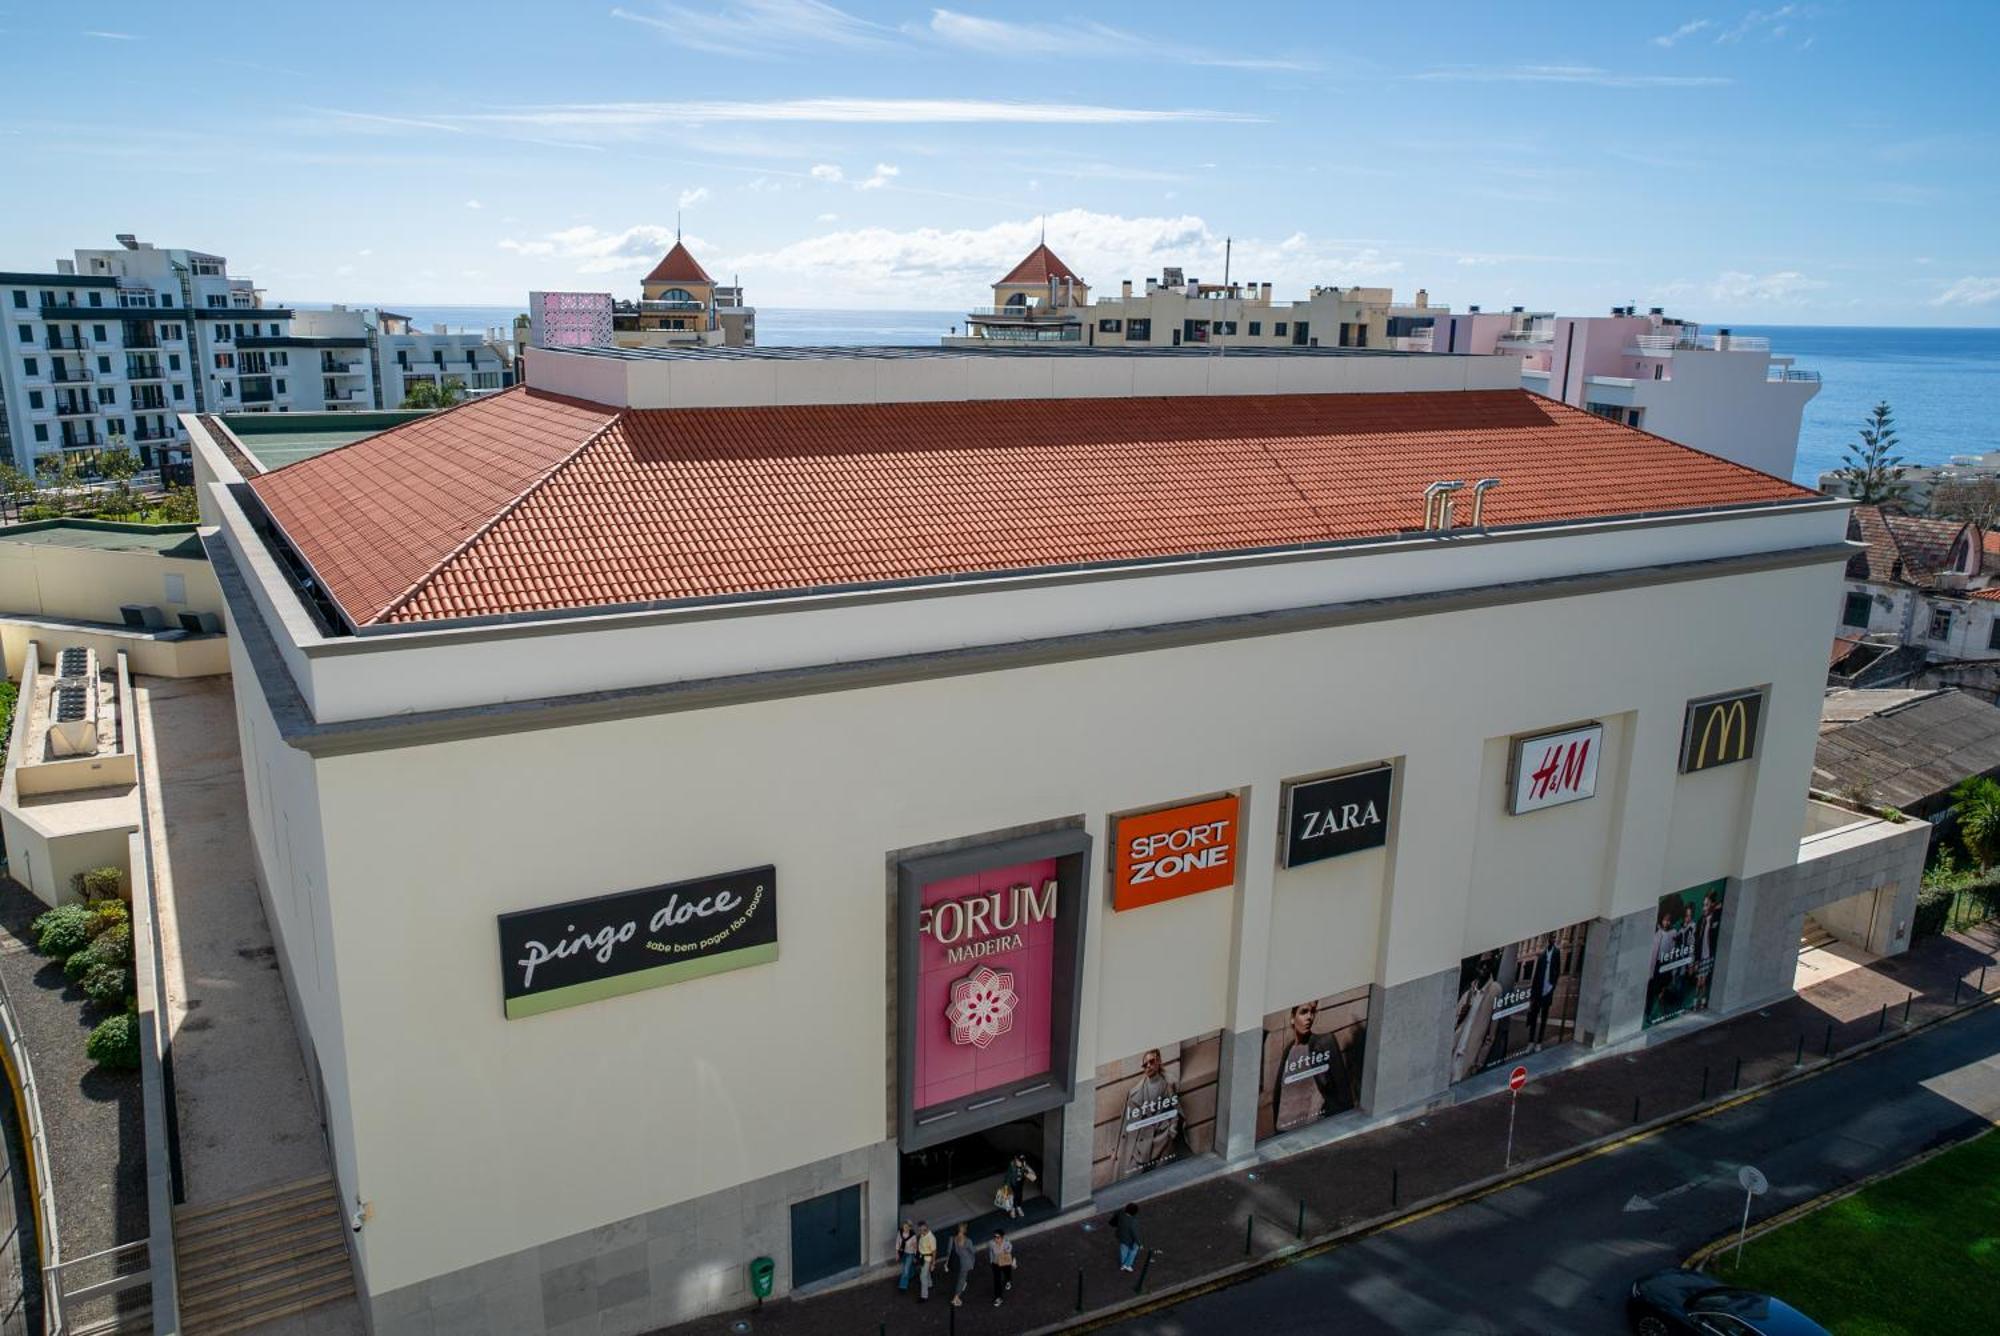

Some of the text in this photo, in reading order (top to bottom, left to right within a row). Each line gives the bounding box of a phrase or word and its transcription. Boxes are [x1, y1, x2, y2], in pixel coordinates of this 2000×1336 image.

[1529, 738, 1591, 800] H&M
[1301, 800, 1381, 841] ZARA
[1130, 821, 1230, 860] SPORT
[1130, 845, 1229, 885] ZONE
[646, 940, 672, 952] sabe
[673, 942, 698, 953] bem
[700, 928, 730, 950] pagar
[745, 884, 764, 918] pouco
[518, 893, 742, 988] pingo doce
[947, 933, 1023, 964] MADEIRA
[1659, 944, 1696, 964] lefties
[1493, 988, 1532, 1010] lefties
[1283, 1049, 1331, 1073] lefties
[1126, 1095, 1178, 1120] lefties
